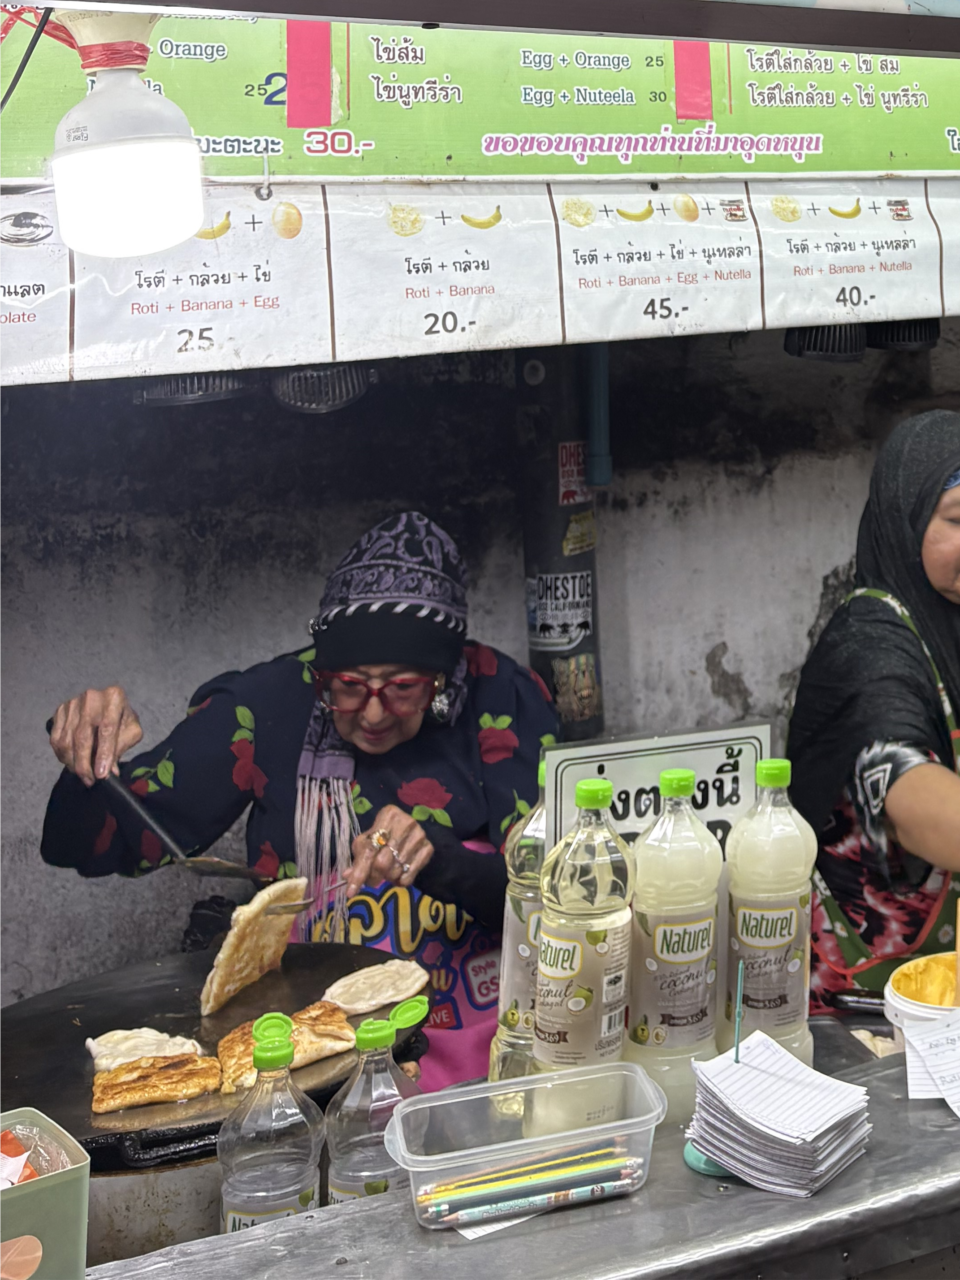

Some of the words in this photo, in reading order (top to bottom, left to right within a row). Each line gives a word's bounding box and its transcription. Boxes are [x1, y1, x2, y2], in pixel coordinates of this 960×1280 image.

[160, 39, 226, 60] Orange
[371, 36, 425, 63] ไข่ส้ม
[521, 50, 553, 69] Egg
[574, 51, 630, 71] Orange
[645, 56, 665, 68] 25
[244, 85, 268, 97] 25
[372, 74, 463, 107] ไข่นูทรีร่า
[521, 87, 554, 106] Egg
[574, 87, 635, 105] Nuteela
[649, 91, 667, 103] 30
[747, 83, 835, 106] โรตีใส่กล้วย
[856, 83, 875, 106] ไข่
[305, 131, 373, 155] 30.-
[483, 124, 821, 162] ขอขอบคุณทุกท่านที่มาอุดหนุน
[573, 248, 598, 265] โรตี
[616, 241, 651, 264] กล้วย
[669, 239, 684, 260] ไข่
[702, 236, 751, 265] นูเทลล่า
[786, 238, 810, 254] โรตี
[825, 232, 856, 253] กล้วย
[405, 257, 433, 275] โรตี
[452, 249, 490, 273] กล้วย
[793, 265, 814, 276] Roti
[828, 263, 866, 275] Banana
[879, 261, 912, 272] Nutella
[135, 269, 166, 289] โรตี
[189, 262, 231, 287] กล้วย
[252, 260, 272, 283] ไข่
[578, 277, 602, 289] Roti
[618, 275, 661, 287] Banana
[677, 271, 698, 285] Egg
[714, 269, 752, 282] Nutella
[405, 287, 430, 299] Roti
[449, 284, 495, 298] Banana
[835, 285, 876, 307] 40.-
[131, 302, 159, 315] Roti
[180, 298, 234, 313] Banana
[254, 295, 281, 310] Egg
[643, 297, 689, 320] 45.-
[423, 311, 477, 336] 20.-
[740, 910, 794, 939] Naturel
[660, 921, 712, 955] Naturel
[540, 939, 577, 972] aturel
[744, 944, 791, 970] oconut
